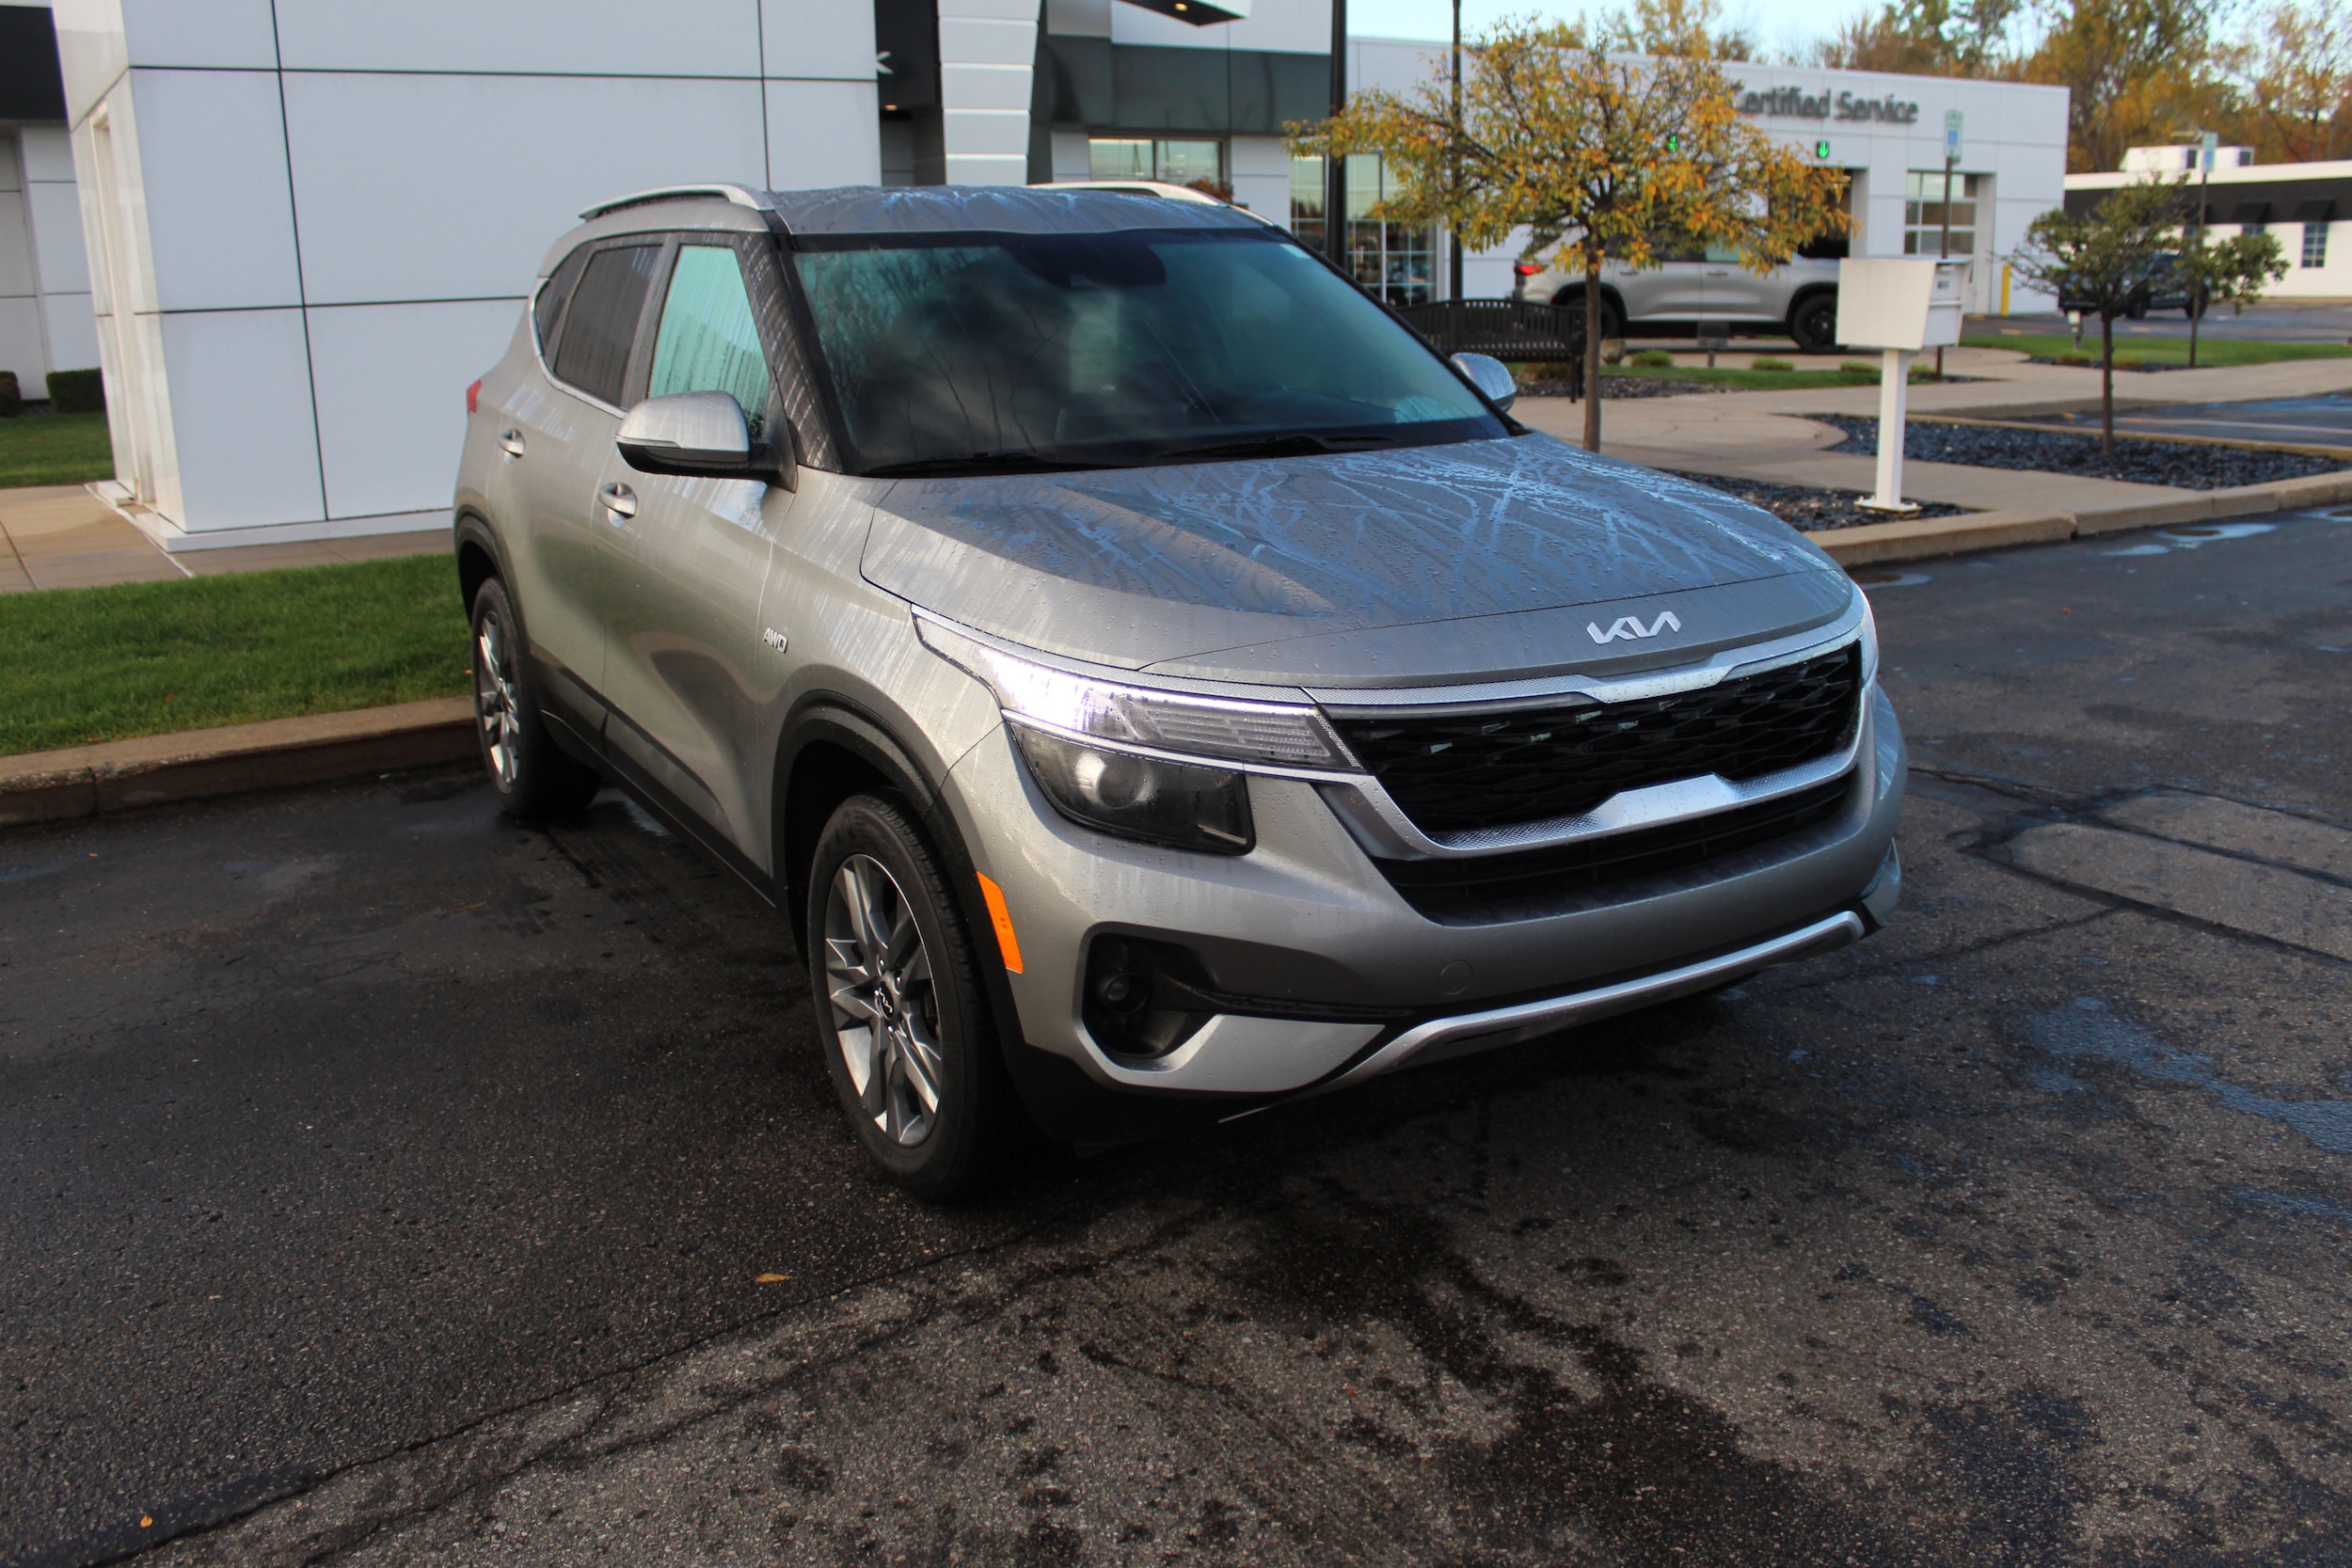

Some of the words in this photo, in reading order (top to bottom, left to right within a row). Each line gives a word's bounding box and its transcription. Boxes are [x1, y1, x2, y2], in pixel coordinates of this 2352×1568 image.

[1834, 90, 1919, 123] Service
[762, 626, 788, 654] AWD
[1586, 610, 1681, 644] KIA
